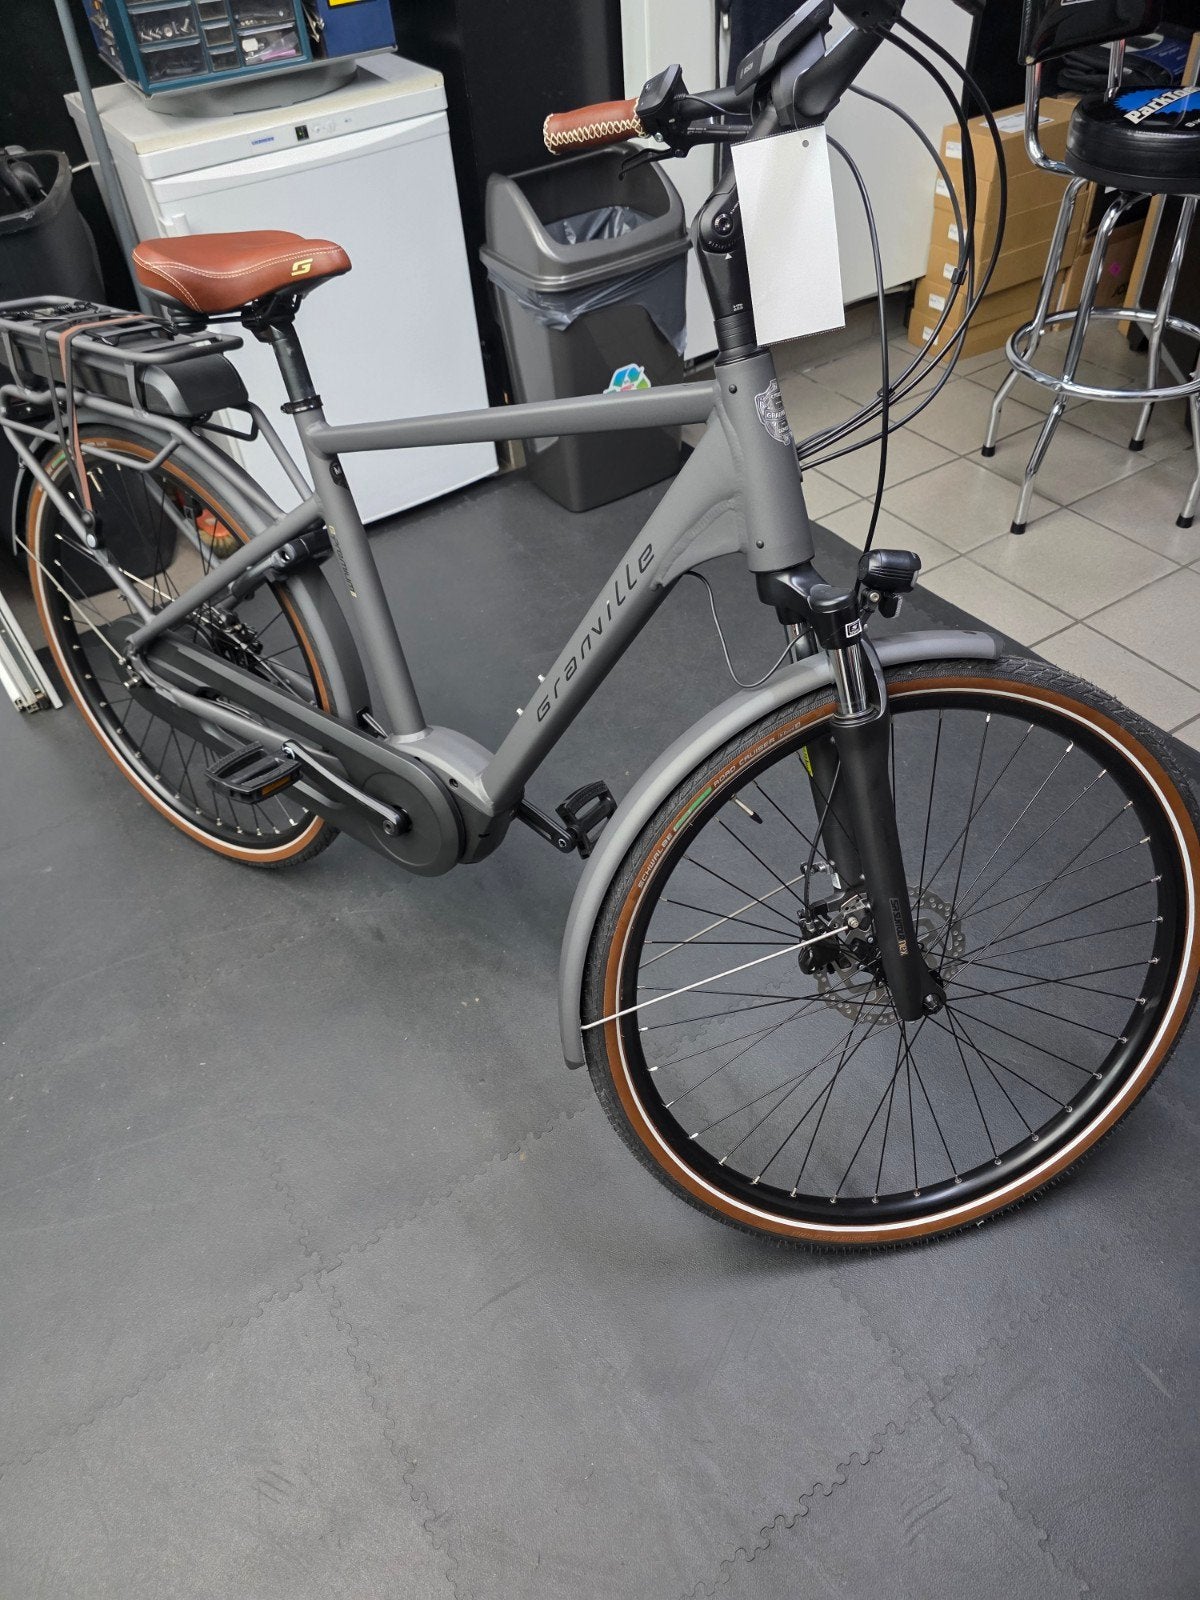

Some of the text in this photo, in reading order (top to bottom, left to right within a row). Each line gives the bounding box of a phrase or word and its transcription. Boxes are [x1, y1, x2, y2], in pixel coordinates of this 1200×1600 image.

[637, 738, 775, 889] SCHWALBE ROAD CRUISER
